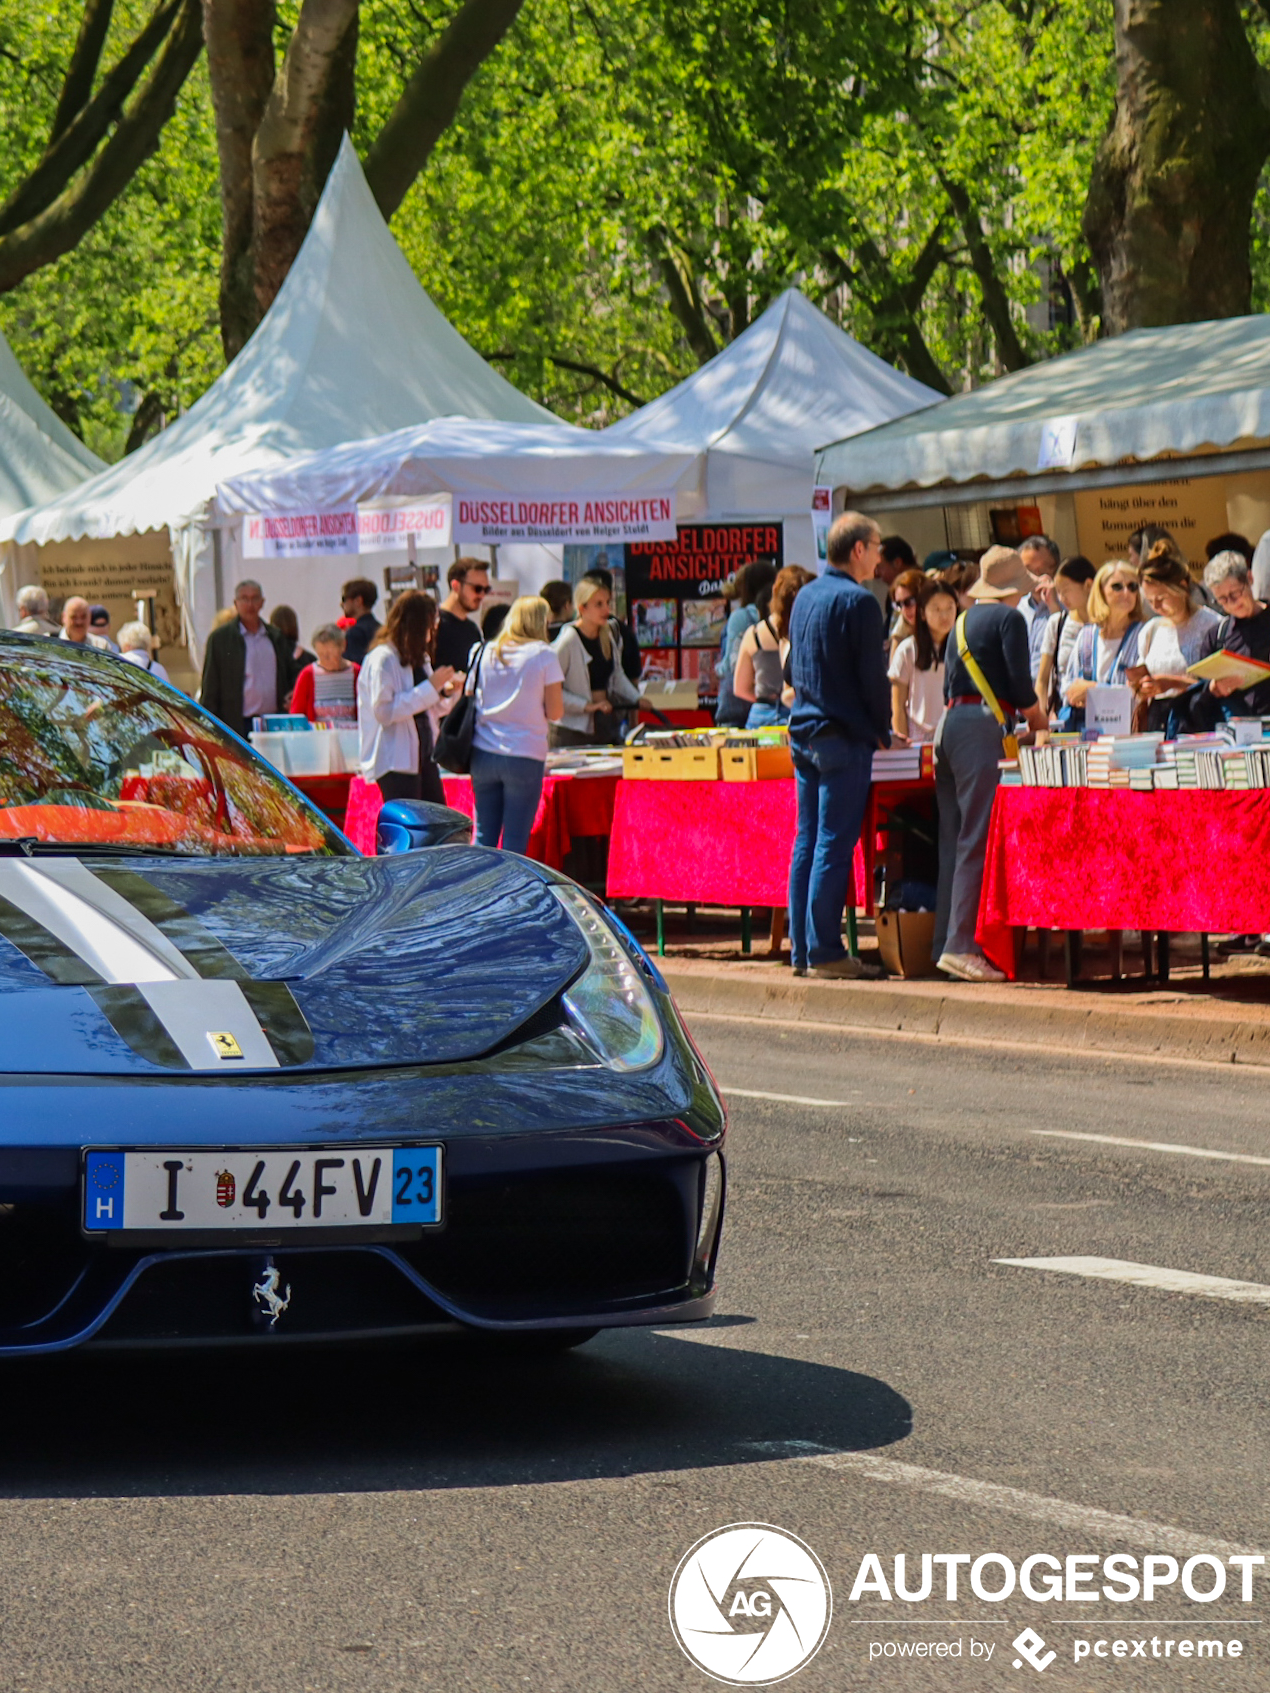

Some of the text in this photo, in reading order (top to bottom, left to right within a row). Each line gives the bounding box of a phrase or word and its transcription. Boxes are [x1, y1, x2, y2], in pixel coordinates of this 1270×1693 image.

[459, 498, 671, 525] DÜSSELDORFER ANSICHTEN
[1100, 496, 1178, 511] hängt über den
[482, 526, 508, 537] Bilder
[511, 528, 526, 537] aus
[527, 525, 573, 537] Düsseldorf
[575, 527, 591, 536] von
[593, 524, 620, 538] Holger
[1180, 516, 1196, 529] die
[160, 1158, 382, 1220] I 44FV
[396, 1167, 434, 1205] 23
[97, 1198, 113, 1219] H
